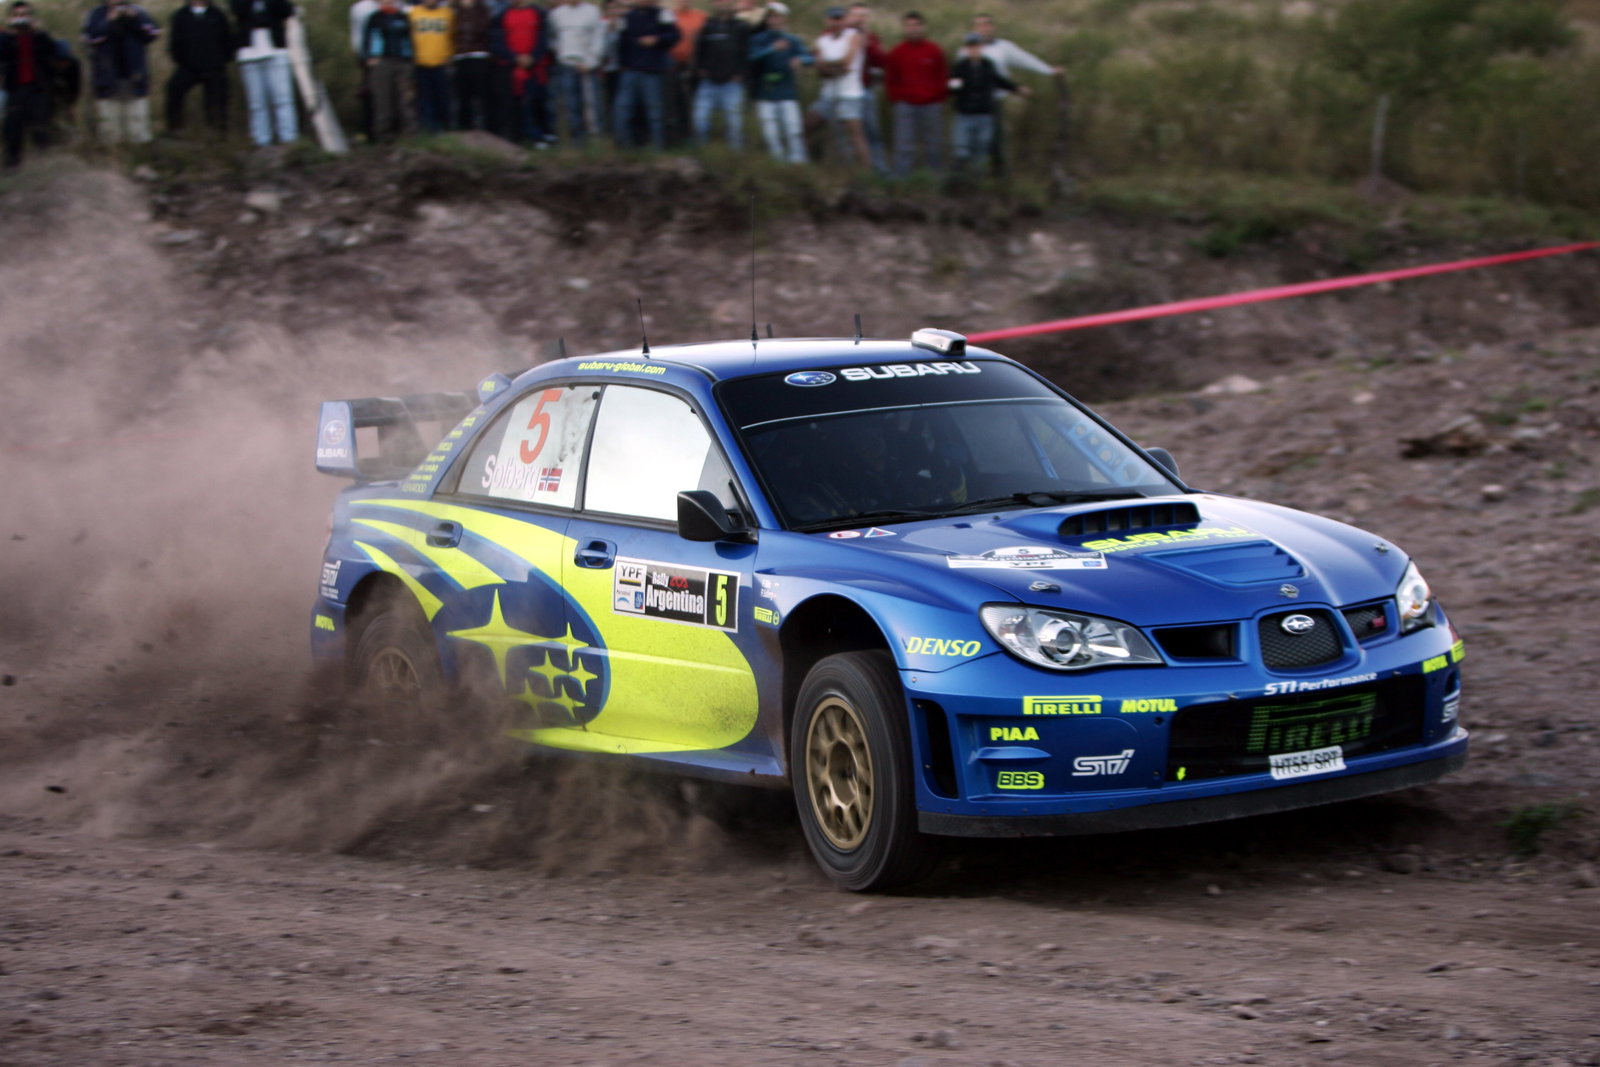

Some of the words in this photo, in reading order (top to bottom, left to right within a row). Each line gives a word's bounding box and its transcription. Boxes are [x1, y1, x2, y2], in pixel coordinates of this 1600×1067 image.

[840, 361, 982, 381] SUBARU
[519, 389, 564, 465] 5
[481, 454, 541, 500] Solberg
[1081, 527, 1250, 550] SUBARU
[620, 564, 644, 579] YPF
[652, 571, 670, 588] Rally
[645, 584, 705, 616] Argentina
[715, 574, 729, 627] 5
[906, 636, 982, 657] DENSO
[1263, 681, 1298, 696] STI
[1298, 672, 1378, 692] Performance
[1022, 695, 1103, 715] PIRELLI
[1120, 698, 1179, 714] MOTUL
[1247, 691, 1378, 752] PIRELLI
[990, 727, 1040, 741] PIAA
[997, 771, 1046, 790] BBS
